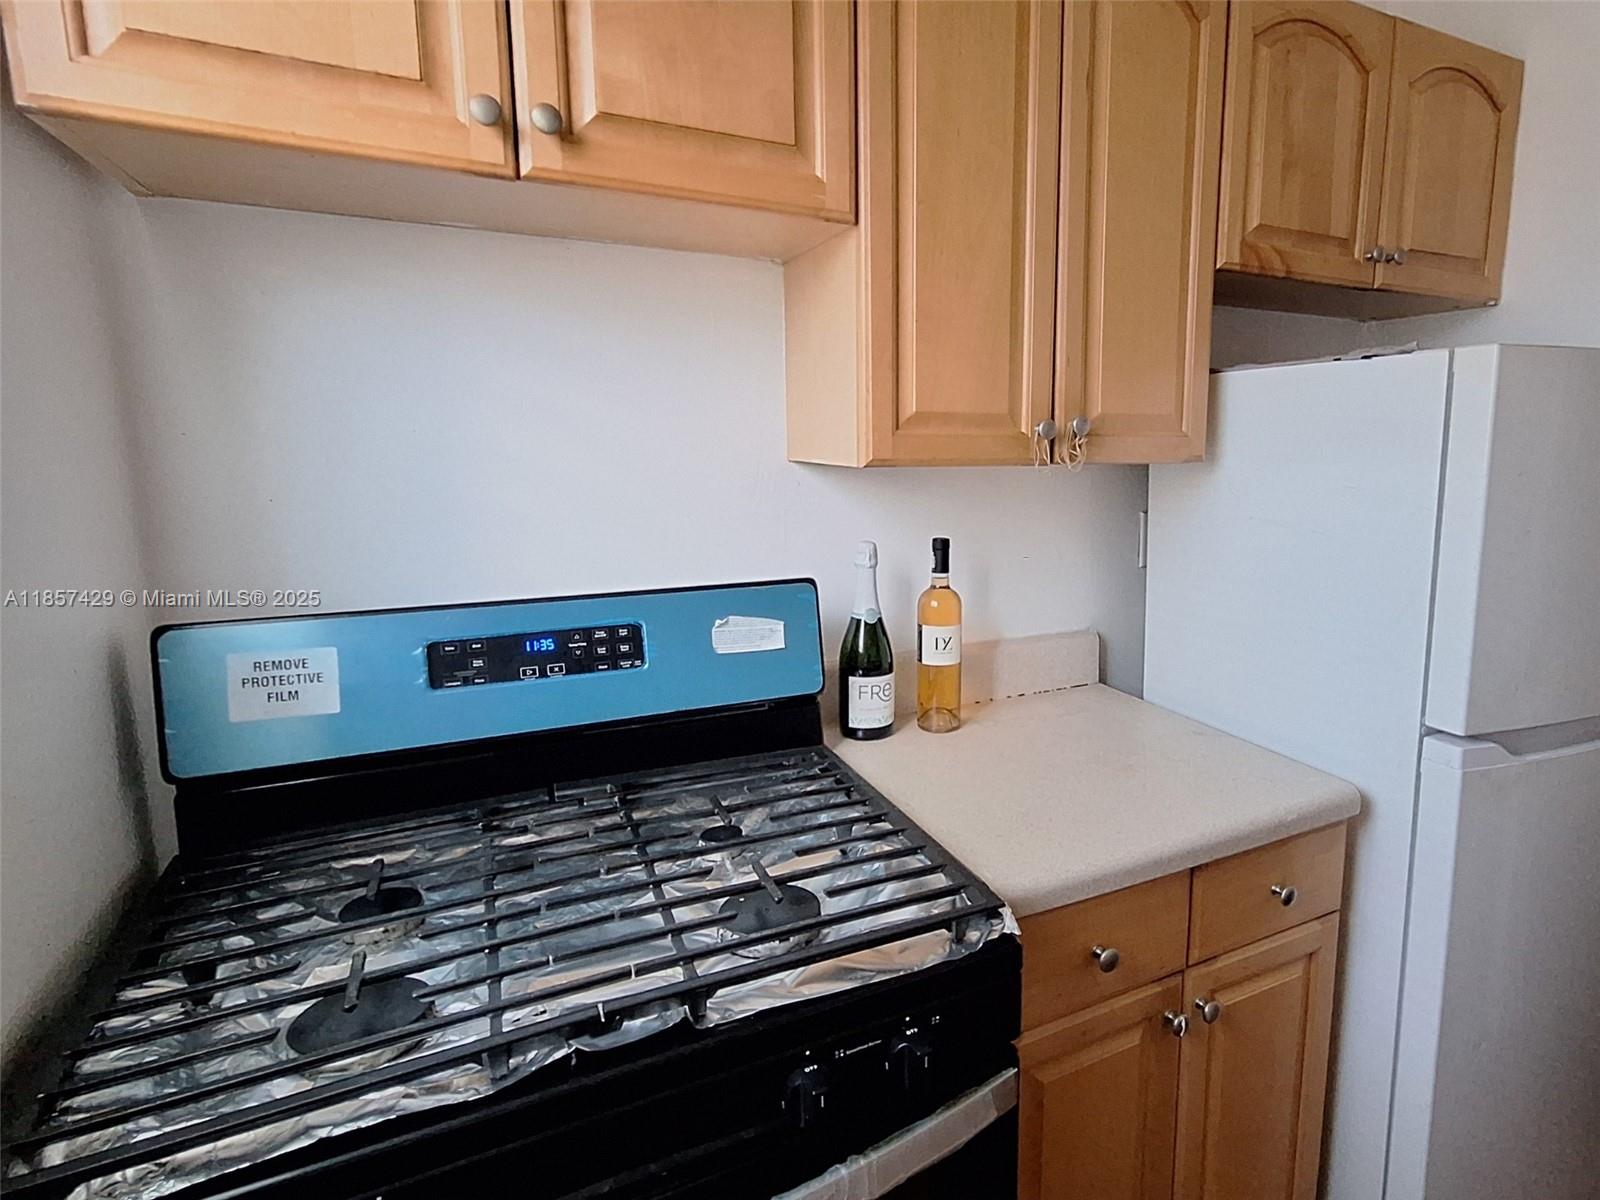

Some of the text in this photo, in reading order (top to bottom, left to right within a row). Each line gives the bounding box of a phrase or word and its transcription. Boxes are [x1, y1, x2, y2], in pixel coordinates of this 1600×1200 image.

[526, 639, 555, 652] 11:35
[253, 658, 309, 672] REMOVE
[241, 672, 324, 688] PROTECTIVE
[267, 690, 300, 703] FILM
